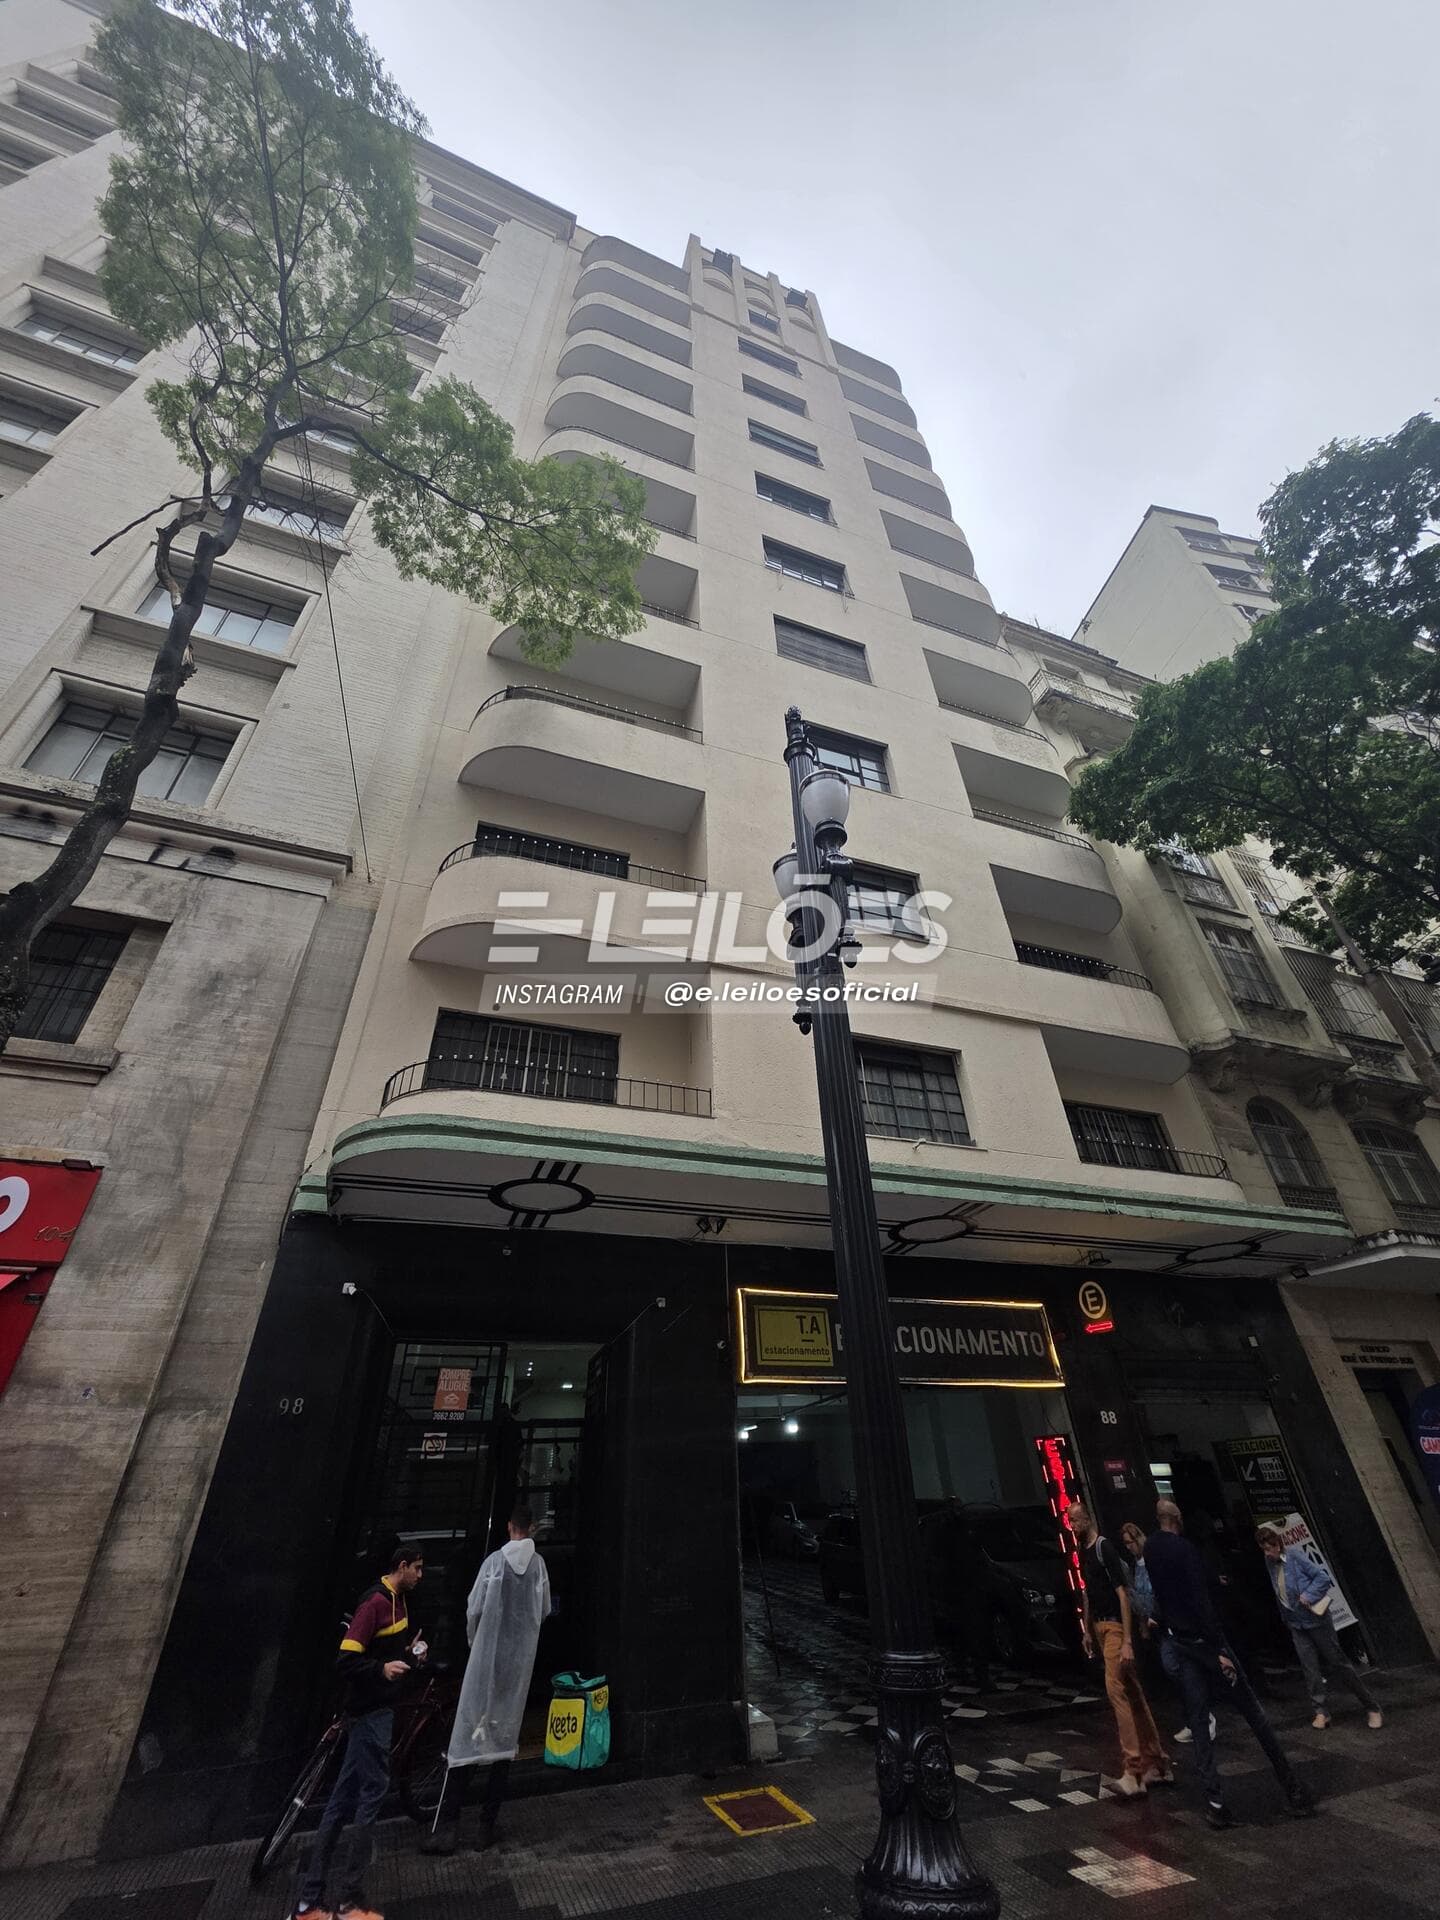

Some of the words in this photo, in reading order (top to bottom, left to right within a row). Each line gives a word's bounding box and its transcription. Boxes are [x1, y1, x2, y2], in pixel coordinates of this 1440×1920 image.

[835, 1322, 1045, 1358] ECIONAMENTO
[764, 1344, 830, 1357] estacionamento
[439, 1368, 472, 1380] COMPRE
[438, 1380, 471, 1392] ALUGUE
[279, 1397, 305, 1416] 98
[1100, 1410, 1118, 1424] 88
